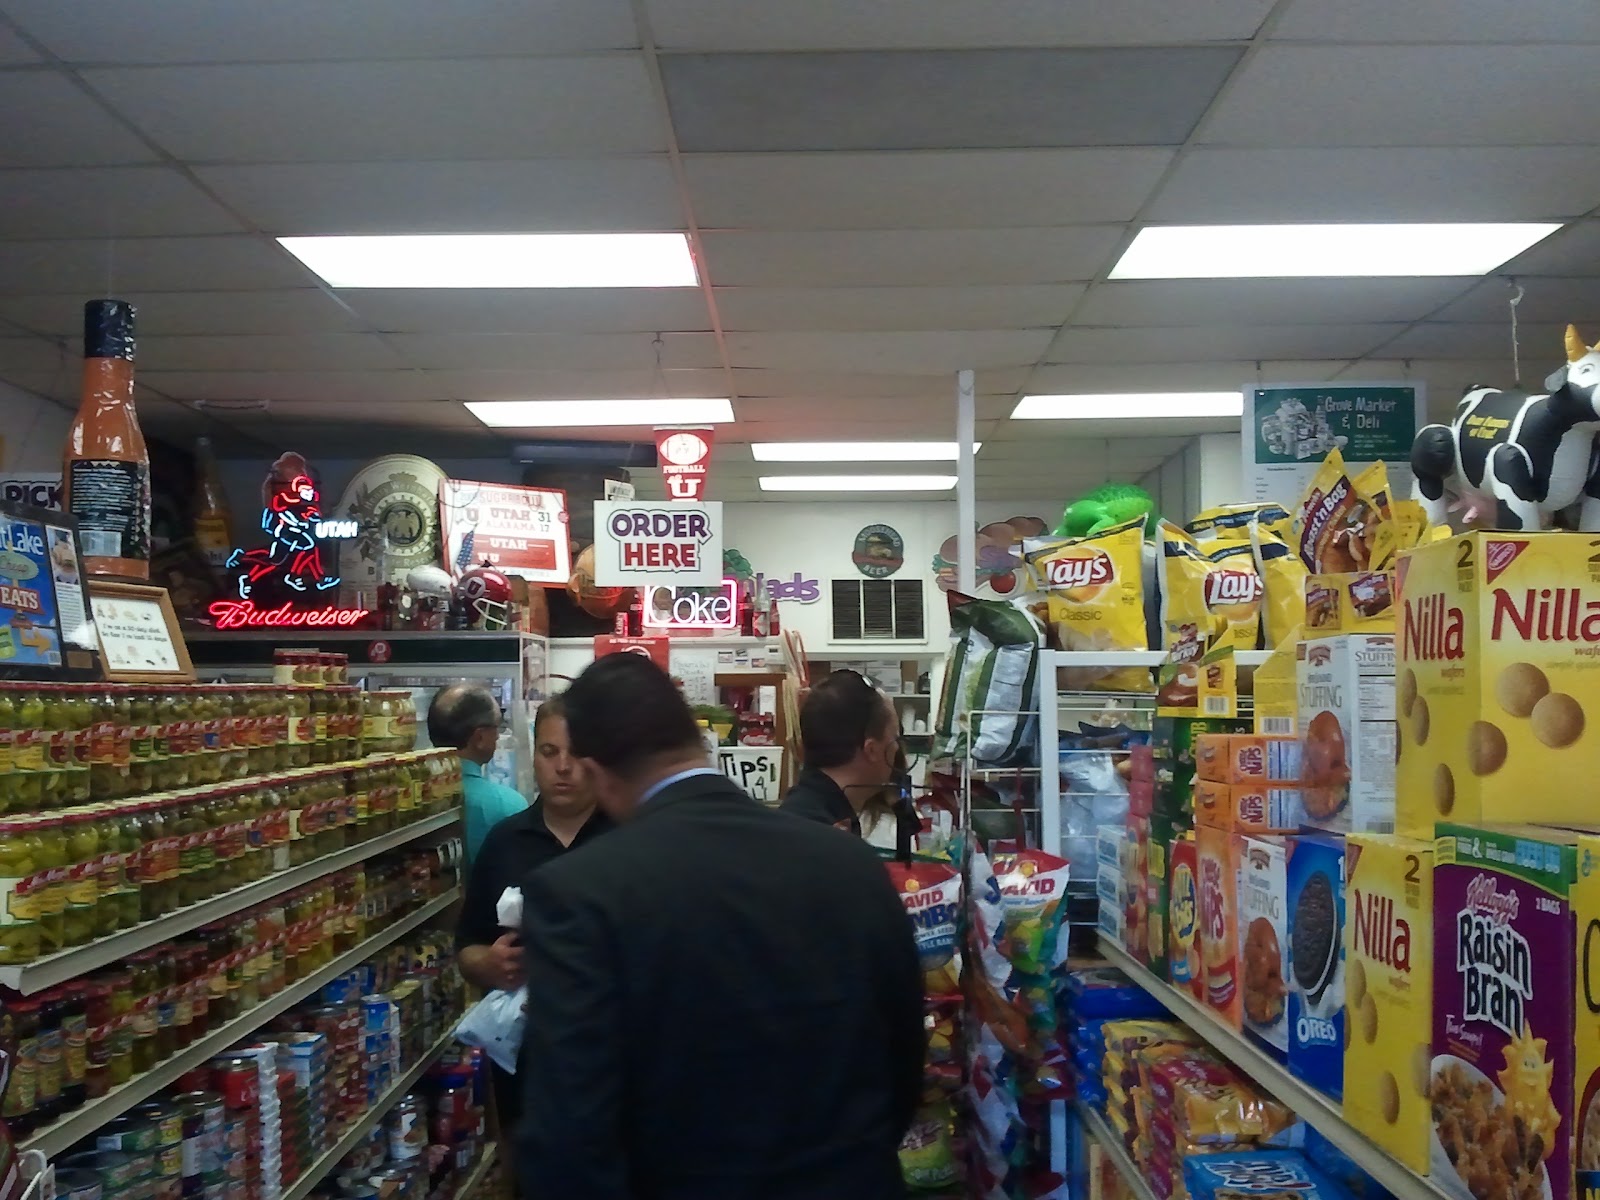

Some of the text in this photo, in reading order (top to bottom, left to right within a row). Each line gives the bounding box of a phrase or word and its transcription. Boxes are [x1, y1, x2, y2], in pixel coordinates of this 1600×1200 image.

[1325, 396, 1397, 412] Grove Market
[1356, 414, 1381, 429] Deli
[485, 520, 536, 532] ALABAMA
[490, 507, 531, 521] UTAH
[537, 511, 551, 523] 31
[611, 512, 708, 538] ORDER
[314, 520, 358, 539] UTAH
[489, 537, 528, 551] UTAH
[624, 542, 696, 568] HERE
[1457, 538, 1474, 568] 2
[862, 564, 889, 576] BEER
[208, 600, 369, 630] Budweiser
[649, 584, 732, 624] Coke
[1060, 608, 1103, 621] Classic
[1491, 588, 1600, 642] Nilla
[1403, 592, 1466, 663] Nilla
[1301, 684, 1342, 708] STUFFING
[1404, 854, 1421, 884] 2
[1353, 887, 1411, 975] Nilla
[1459, 911, 1531, 997] Raisin
[1466, 965, 1523, 1040] Bran
[1296, 1016, 1337, 1042] OREO
